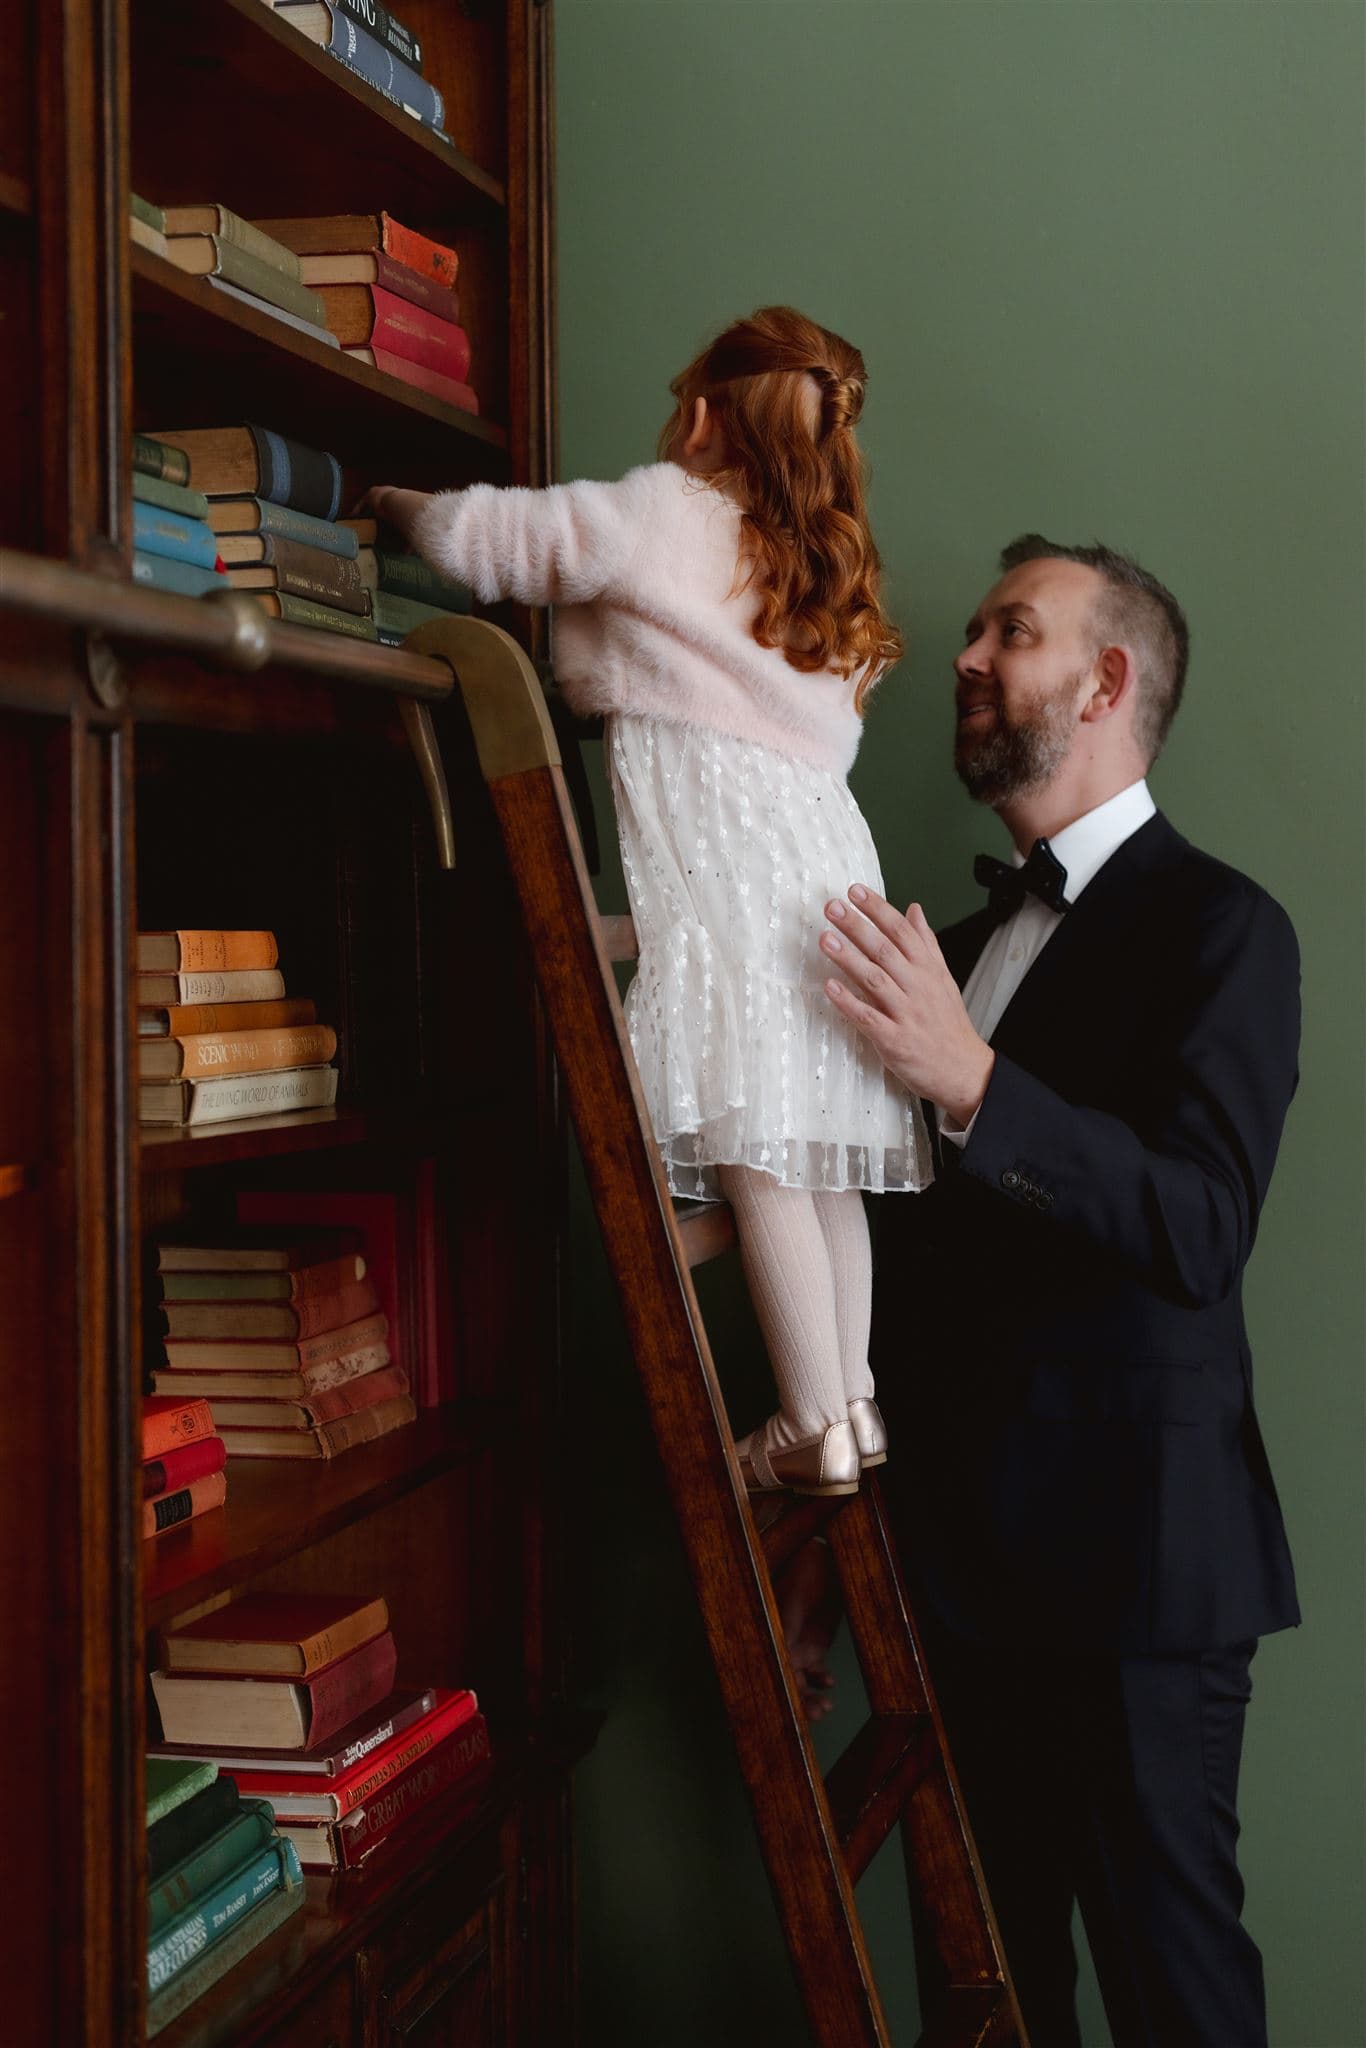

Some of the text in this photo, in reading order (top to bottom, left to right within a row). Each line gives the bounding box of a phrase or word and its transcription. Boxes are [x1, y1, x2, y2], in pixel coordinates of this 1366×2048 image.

[198, 1042, 230, 1066] SCENIC
[202, 1081, 311, 1108] THE LIVING WORLD OF ANIMALS
[355, 1720, 394, 1758] Queensland
[367, 1786, 407, 1834] GREAT
